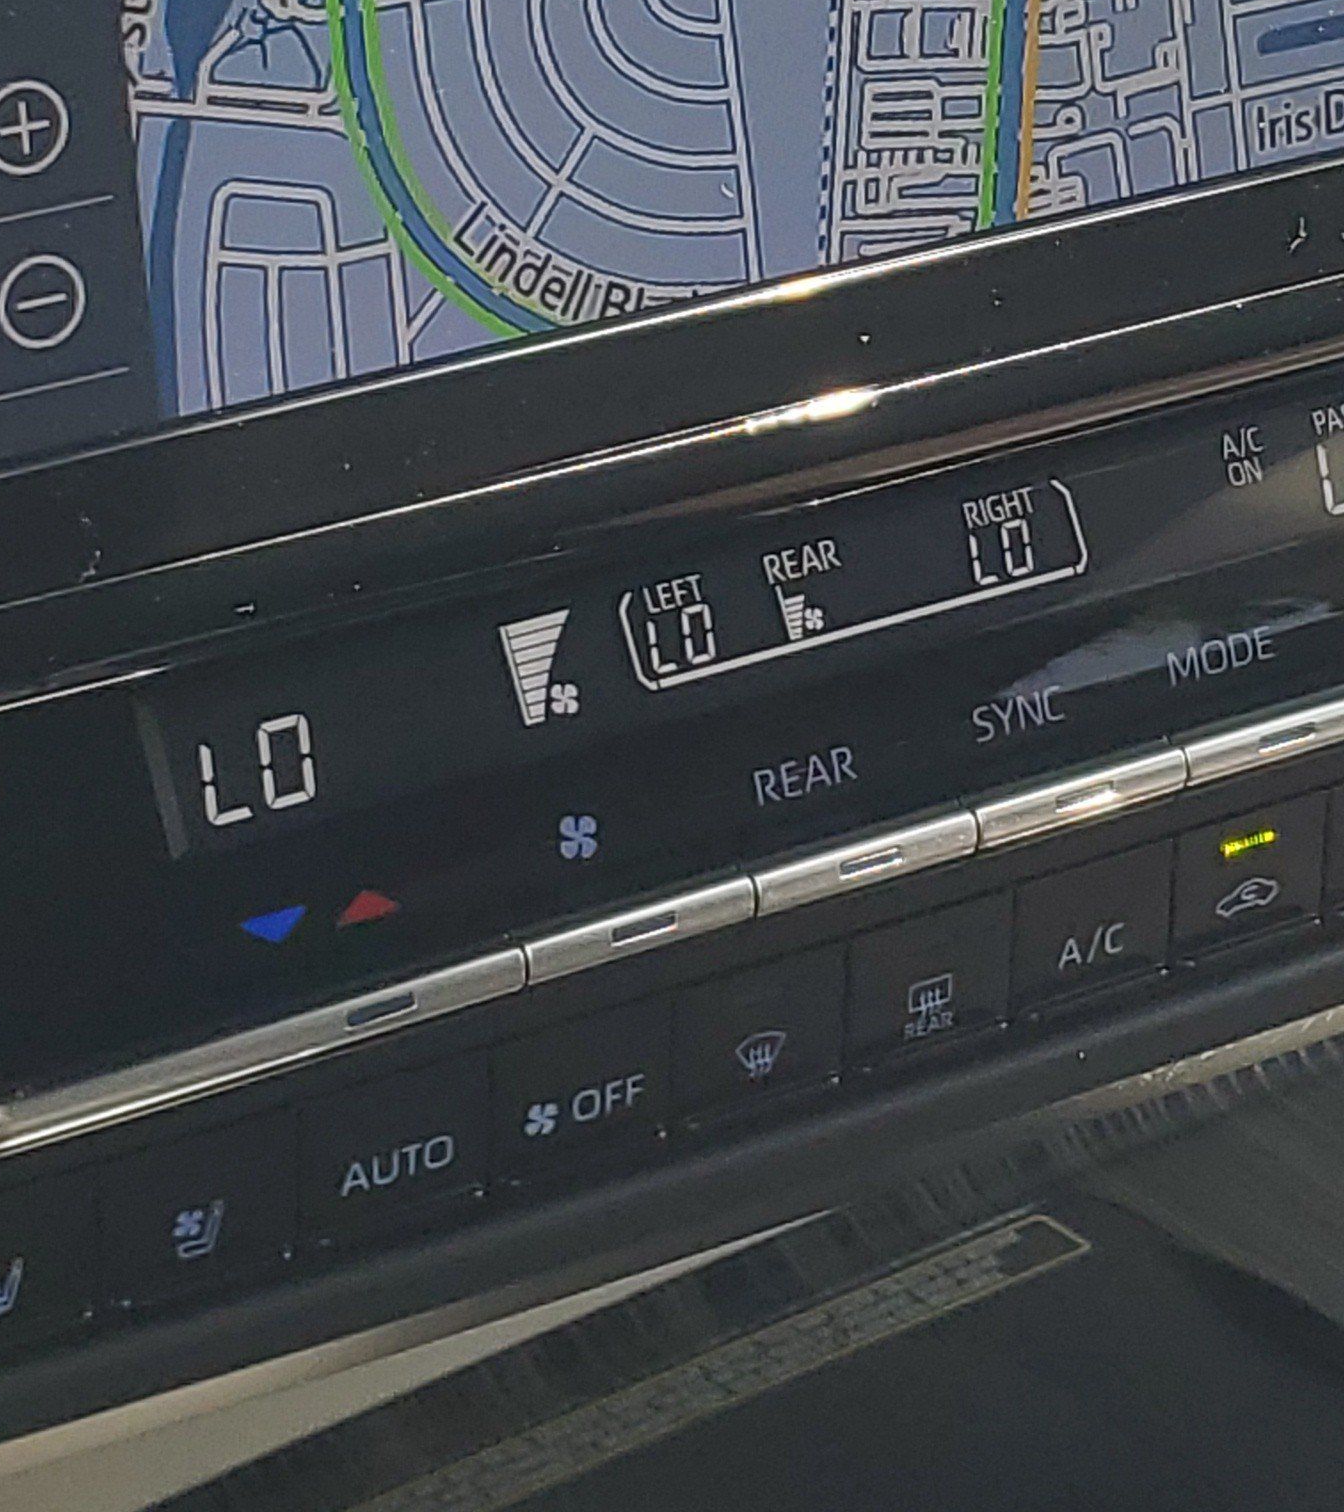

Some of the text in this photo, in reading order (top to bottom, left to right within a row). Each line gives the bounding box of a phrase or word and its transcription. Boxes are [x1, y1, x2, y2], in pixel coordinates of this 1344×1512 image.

[1257, 101, 1313, 153] Iris
[453, 201, 593, 321] Lindell
[1223, 427, 1264, 460] A/C
[1227, 457, 1263, 486] ON
[962, 486, 1034, 529] RIGHT
[762, 540, 843, 583] REAR
[643, 574, 704, 615] LEFT
[1165, 625, 1275, 685] MODE
[971, 686, 1066, 744] SYNC
[753, 746, 857, 807] REAR
[1057, 922, 1125, 970] A/C
[570, 1074, 646, 1124] OFF
[340, 1135, 455, 1197] AUTO
